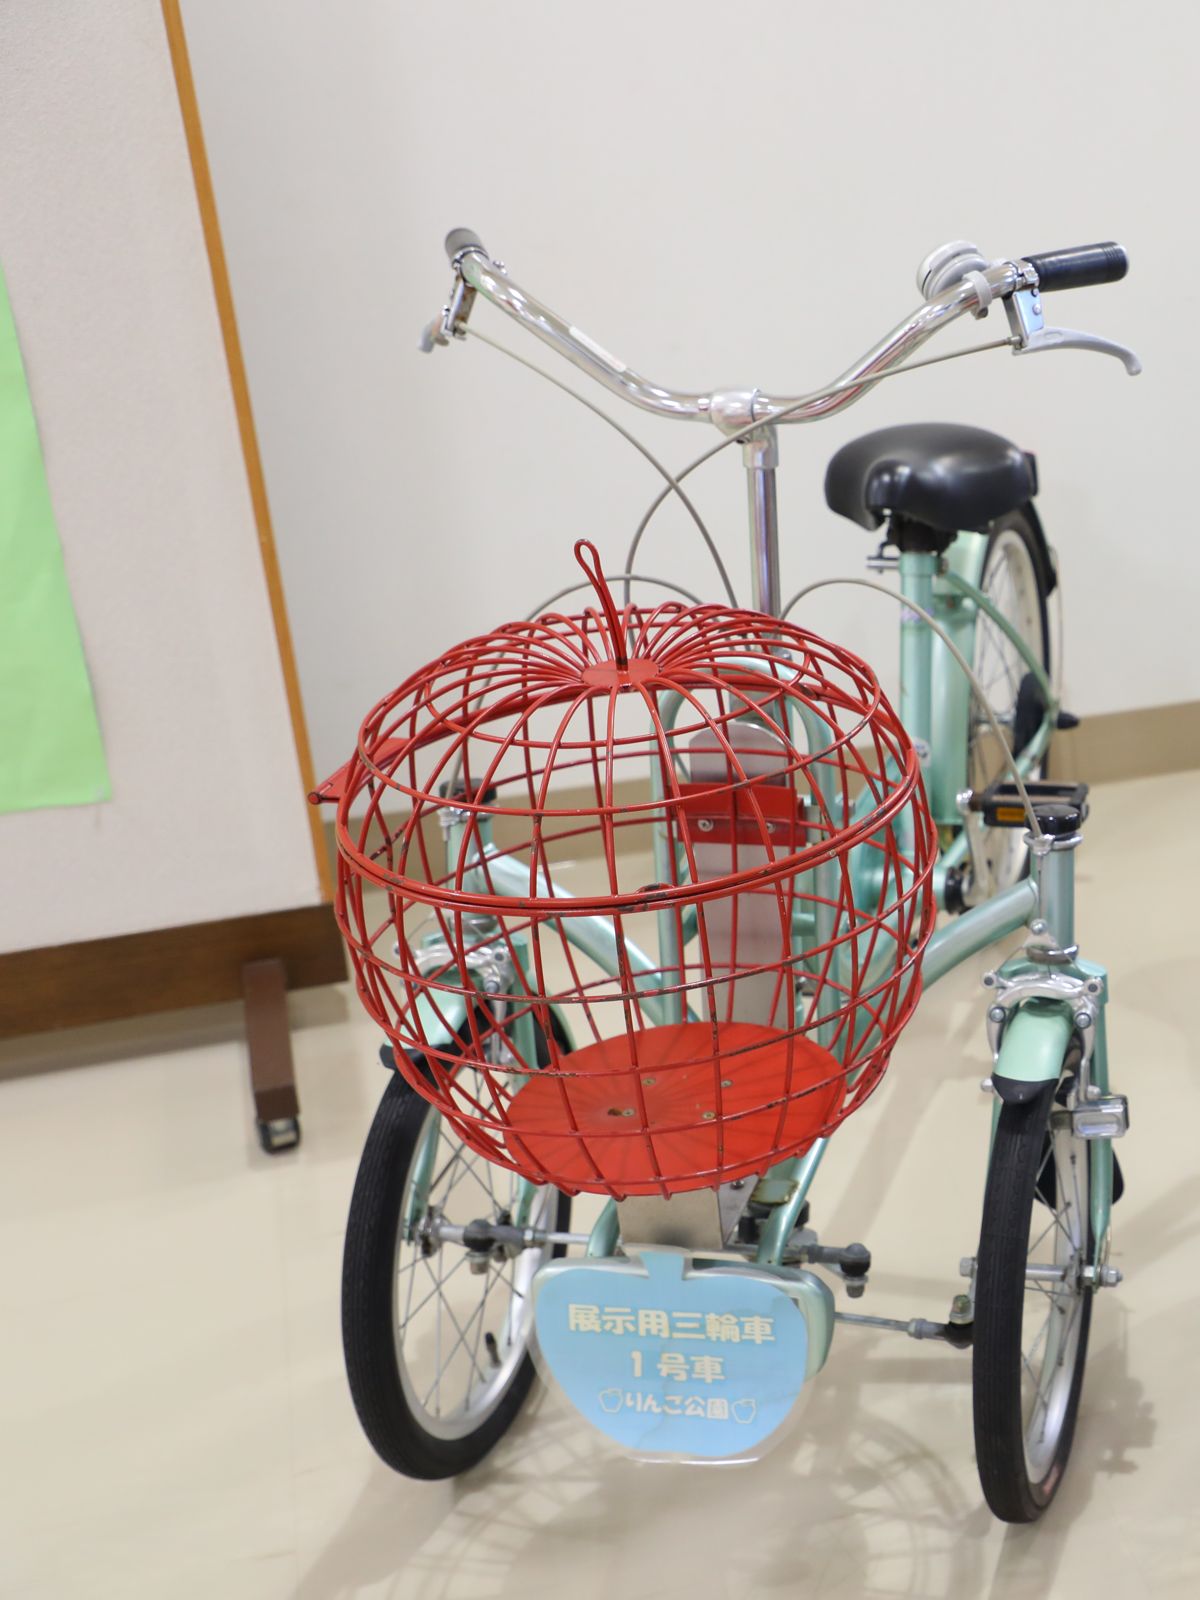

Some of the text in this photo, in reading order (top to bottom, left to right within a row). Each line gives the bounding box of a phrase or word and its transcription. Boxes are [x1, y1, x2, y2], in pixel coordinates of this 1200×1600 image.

[568, 1303, 775, 1344] 展示用三輪車
